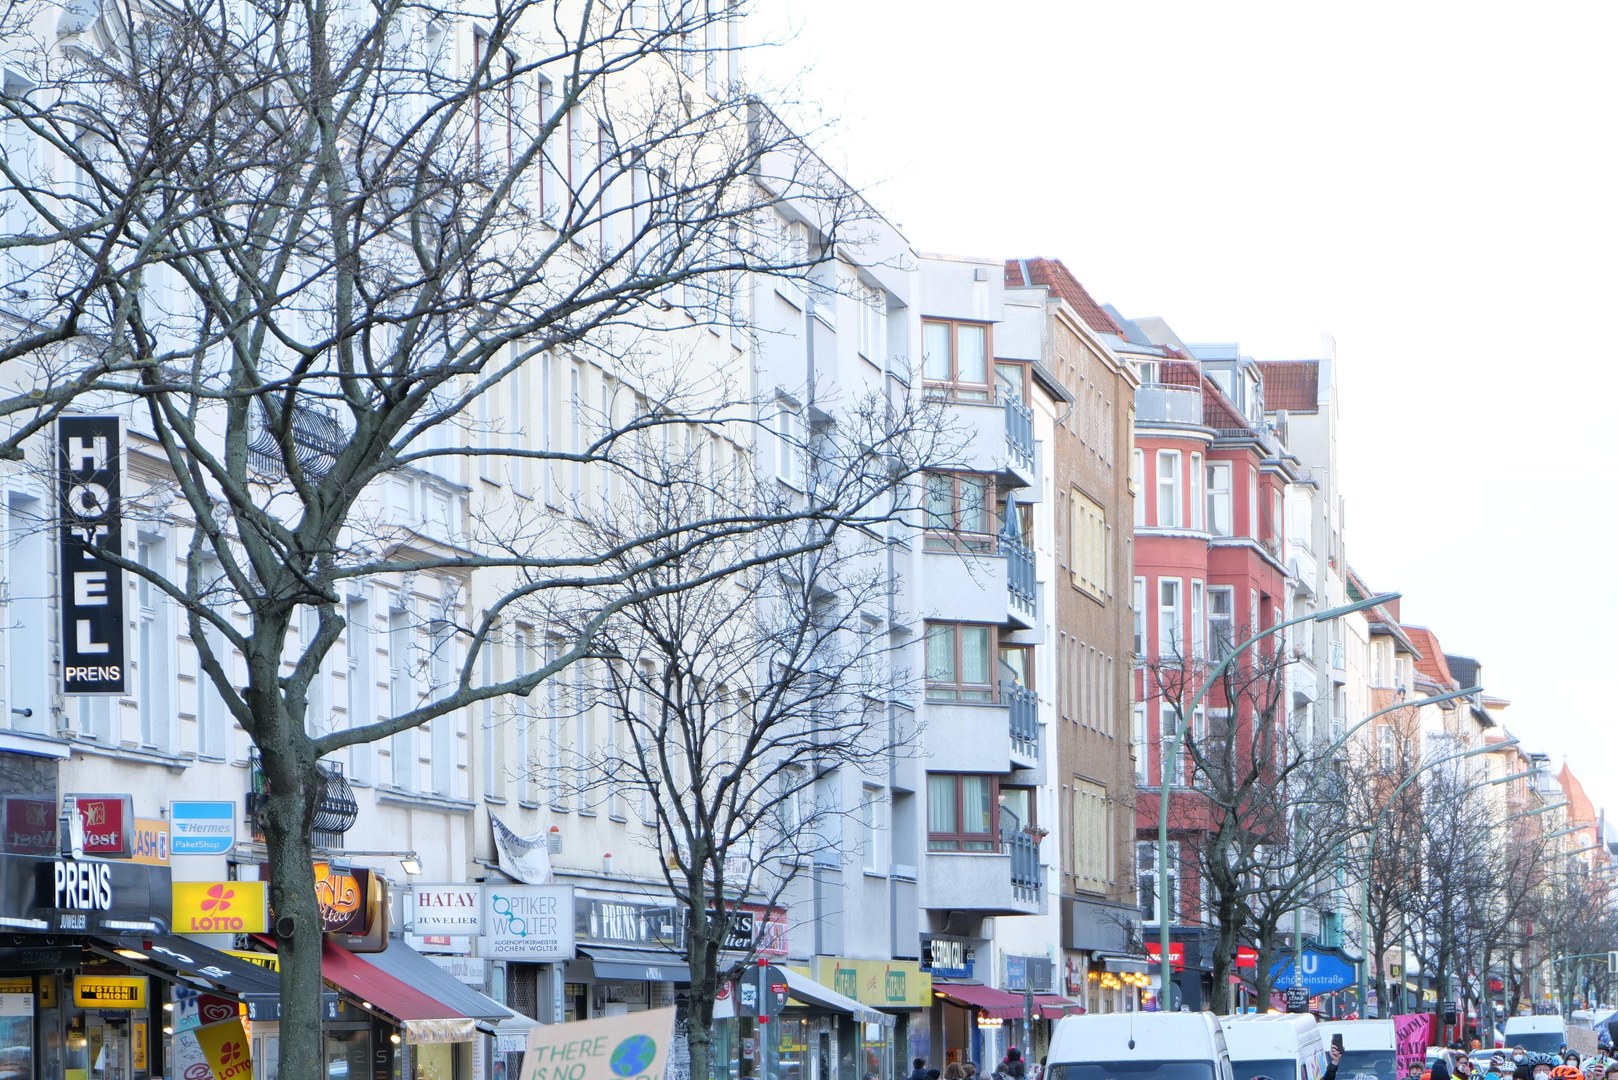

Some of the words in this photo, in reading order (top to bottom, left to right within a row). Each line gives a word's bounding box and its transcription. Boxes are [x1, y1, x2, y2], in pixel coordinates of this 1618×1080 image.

[69, 435, 111, 654] HOTEL
[65, 665, 121, 682] PRENS
[189, 823, 231, 833] Hermes
[175, 840, 220, 849] PaketShop
[55, 861, 112, 911] PRENS
[418, 892, 478, 907] HATAY
[492, 896, 557, 915] OPTIKER
[59, 914, 87, 930] JUWELIER
[191, 916, 244, 931] LOTTO
[417, 917, 478, 925] JUWELIER
[492, 917, 558, 936] WOLTER
[601, 903, 637, 942] PRENS
[1301, 955, 1318, 974] U
[81, 985, 128, 993] WESTERN
[1396, 1014, 1429, 1041] KLIMA
[534, 1036, 609, 1064] THERE
